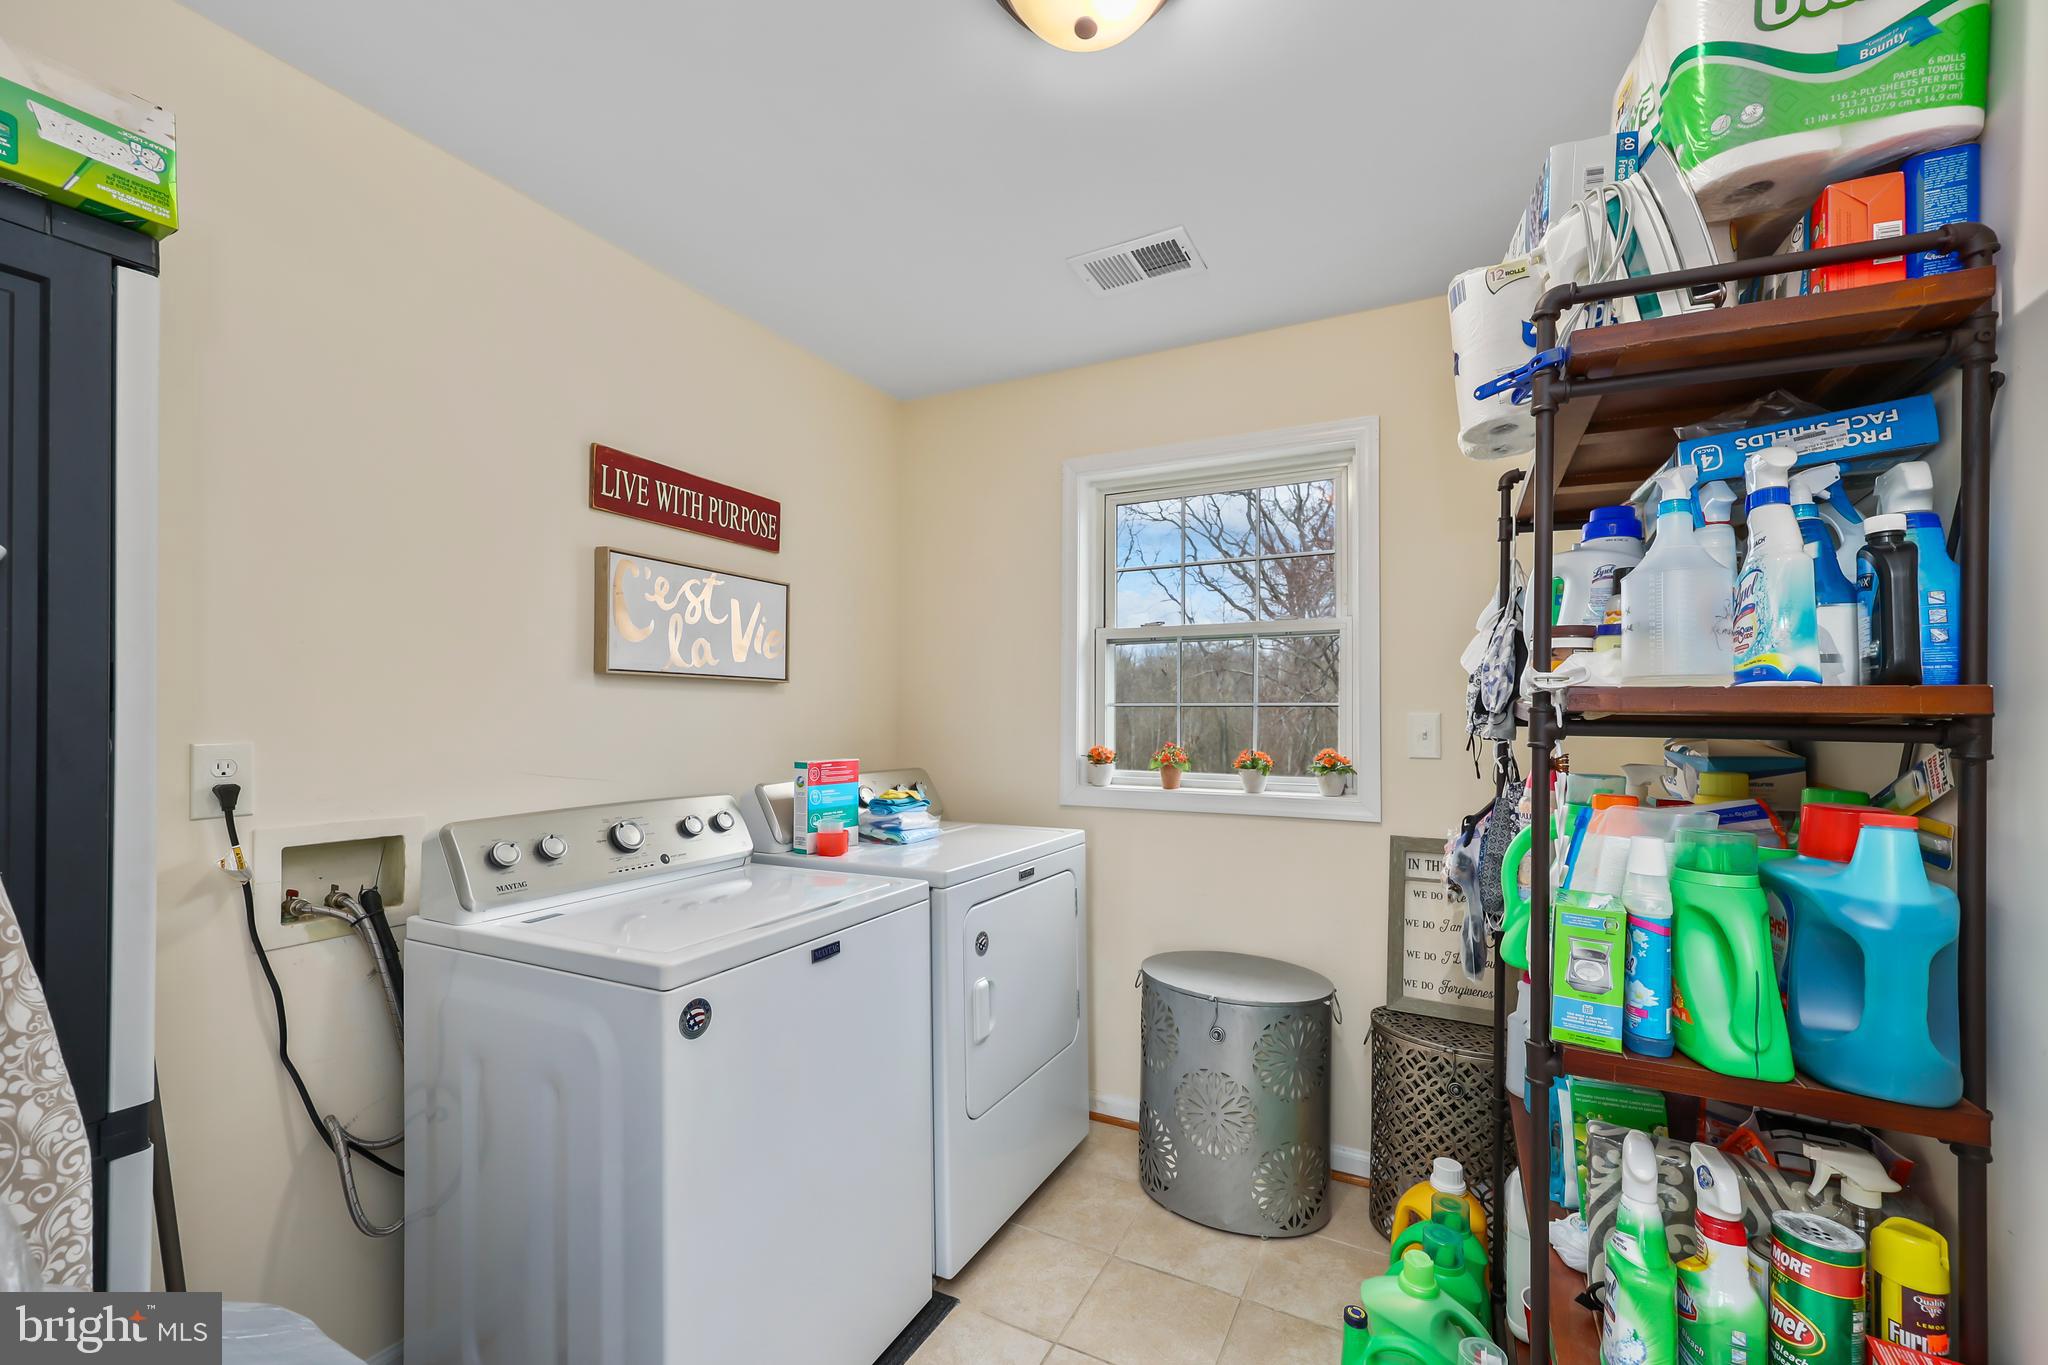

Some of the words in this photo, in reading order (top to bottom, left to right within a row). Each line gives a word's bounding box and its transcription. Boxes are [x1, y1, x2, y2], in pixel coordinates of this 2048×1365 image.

[1859, 30, 1908, 60] Bounty
[1928, 57, 1935, 65] 6
[1936, 53, 1966, 63] ROLLS
[1893, 68, 1925, 81] PAPER
[1928, 63, 1966, 74] TOWELS
[1831, 93, 1848, 102] 116
[1851, 86, 1878, 99] 2-PLY
[1879, 79, 1919, 92] SHEETS
[1921, 75, 1940, 85] PER
[1942, 72, 1965, 82] ROLL
[1869, 93, 1898, 104] TOTAL
[1901, 88, 1915, 97] SQ
[1918, 85, 1930, 95] FT
[1805, 116, 1815, 125] 11
[1818, 113, 1829, 123] IN
[1840, 109, 1856, 119] 5.9
[1857, 106, 1868, 116] IN
[1898, 98, 1913, 107] cm
[1624, 137, 1636, 151] 60
[1488, 268, 1505, 282] 12
[1504, 266, 1526, 277] ROLLS
[1697, 447, 1716, 455] PACK
[1699, 454, 1715, 470] 4
[601, 464, 650, 507] LIVE
[655, 479, 704, 521] WITH
[708, 496, 777, 541] PURPOSE
[612, 559, 729, 643] C'est
[730, 598, 784, 663] Vie
[661, 612, 721, 672] la
[1927, 757, 1936, 790] Drains
[1932, 754, 1942, 794] Unclogs
[1408, 858, 1420, 870] IN
[496, 881, 528, 893] MAYTAG
[1413, 889, 1428, 899] WE
[1430, 891, 1443, 901] DO
[1405, 918, 1419, 928] WE
[1422, 920, 1435, 930] DO
[1406, 949, 1421, 959] WE
[1423, 951, 1437, 961] DO
[1403, 978, 1418, 989] WE
[1421, 980, 1434, 990] DO
[1438, 979, 1494, 1000] Forgivenes
[1772, 1244, 1813, 1278] MORE
[1912, 1295, 1946, 1309] Quality
[1920, 1304, 1943, 1317] Care
[1770, 1305, 1808, 1341] met
[1916, 1321, 1945, 1331] LEMON
[1681, 1327, 1704, 1357] Bleach
